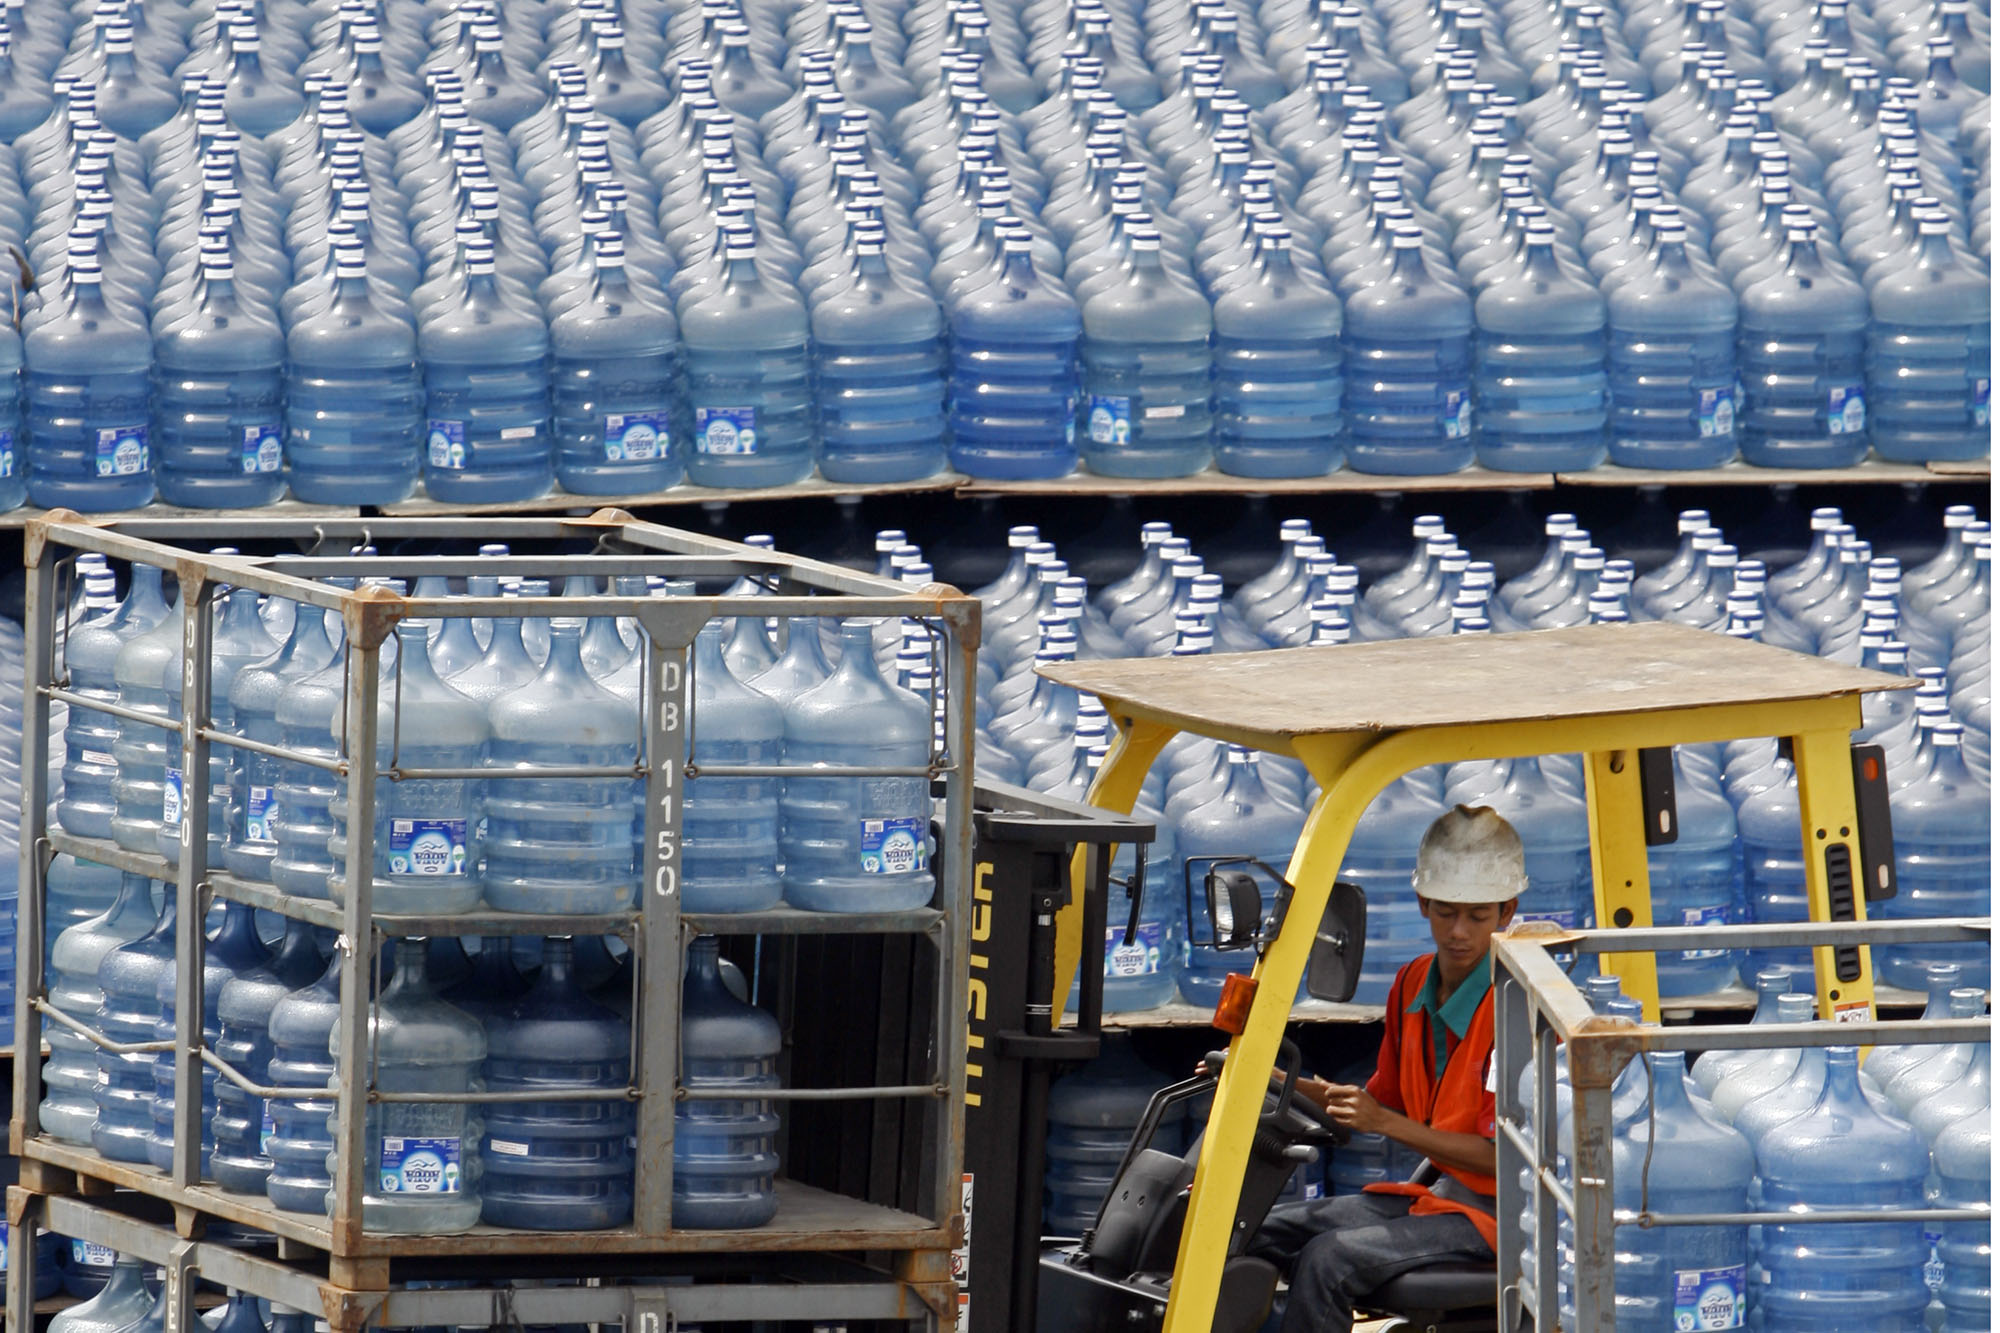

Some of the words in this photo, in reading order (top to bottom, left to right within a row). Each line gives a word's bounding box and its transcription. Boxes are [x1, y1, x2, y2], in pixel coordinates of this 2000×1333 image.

[185, 619, 196, 687] DB
[661, 661, 680, 731] DB
[181, 713, 192, 847] 1150
[656, 759, 675, 896] 1150
[413, 850, 449, 865] AQUA
[884, 848, 914, 863] AQUA
[404, 1168, 441, 1183] AQUA
[1699, 1303, 1734, 1321] AQUA
